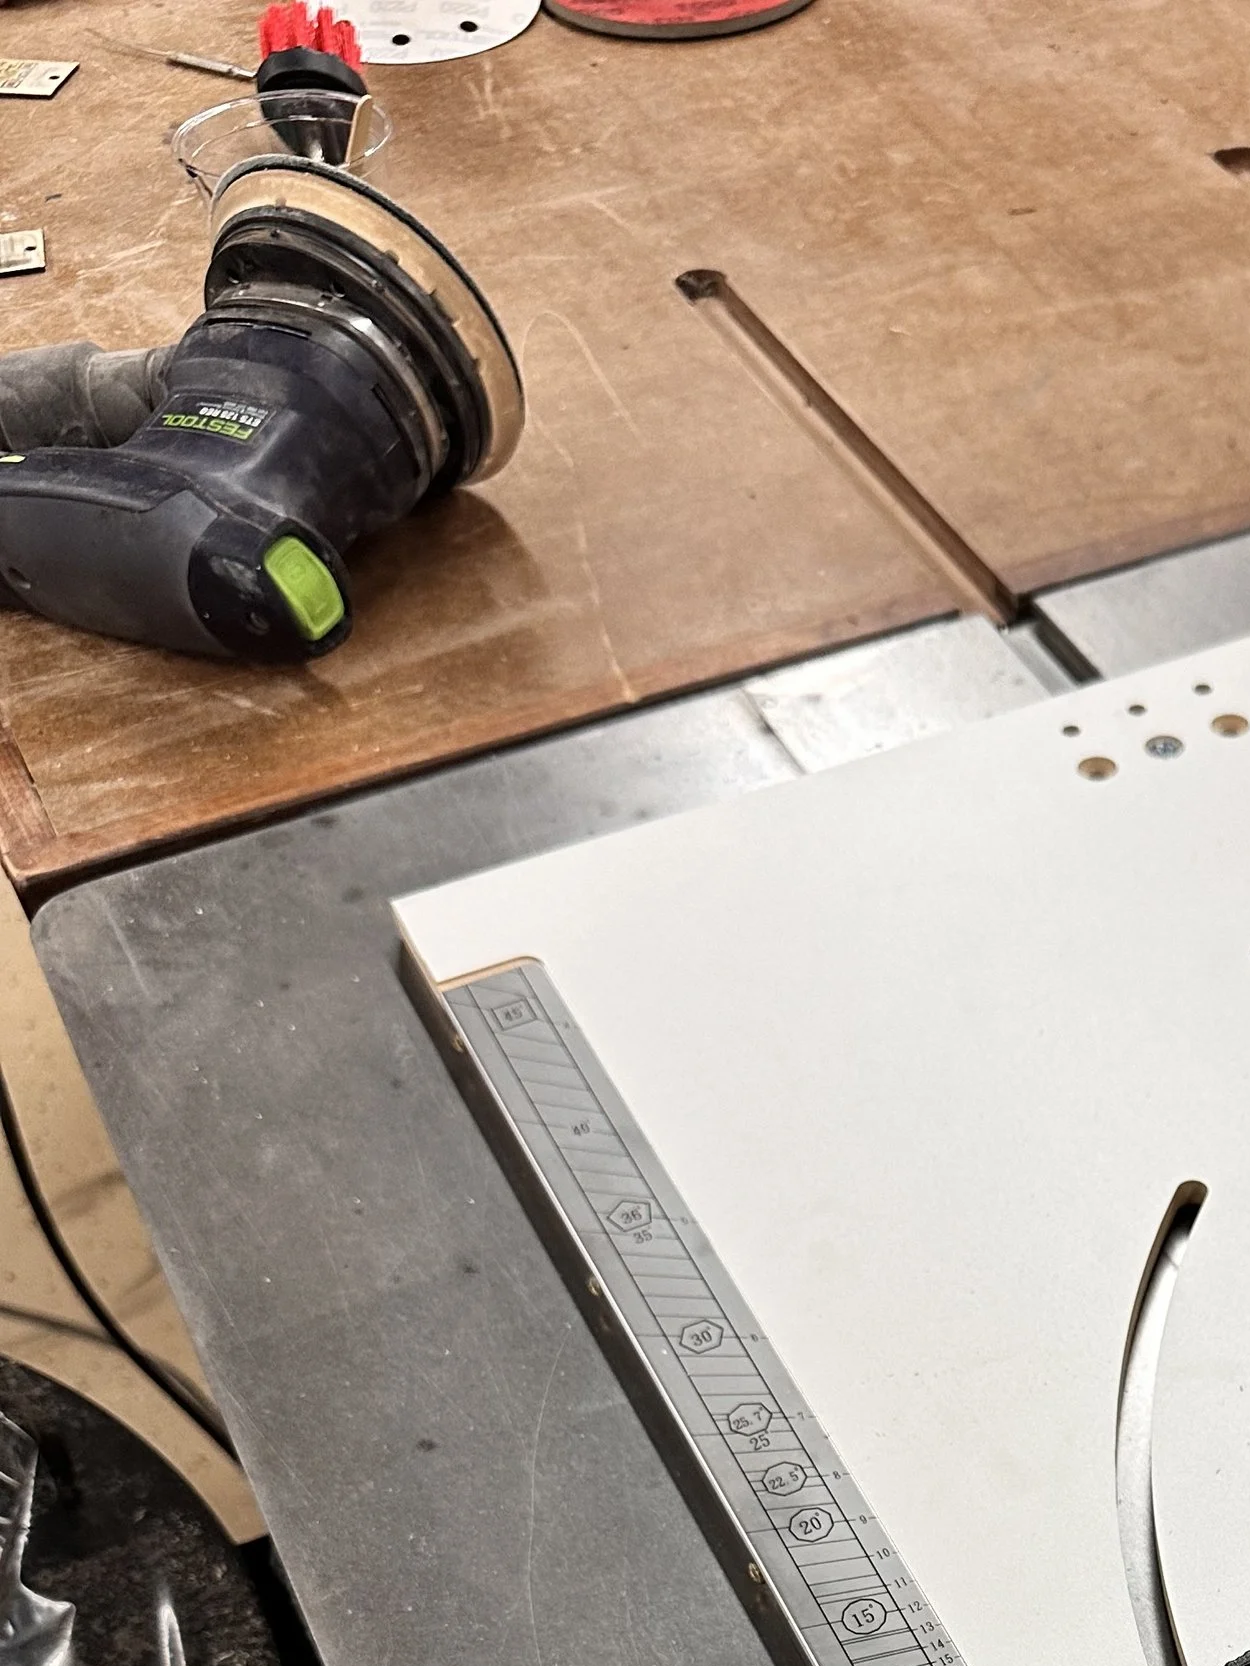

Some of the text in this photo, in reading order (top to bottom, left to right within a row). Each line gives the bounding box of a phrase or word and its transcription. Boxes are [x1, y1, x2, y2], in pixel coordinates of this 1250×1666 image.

[162, 414, 254, 440] FESTOOL
[832, 1470, 841, 1480] 8
[859, 1514, 867, 1525] 9
[876, 1547, 891, 1560] 10
[894, 1576, 908, 1589] 11
[908, 1600, 923, 1614] 12
[920, 1621, 935, 1634] 13
[930, 1638, 945, 1651] 14
[939, 1653, 954, 1666] 15
